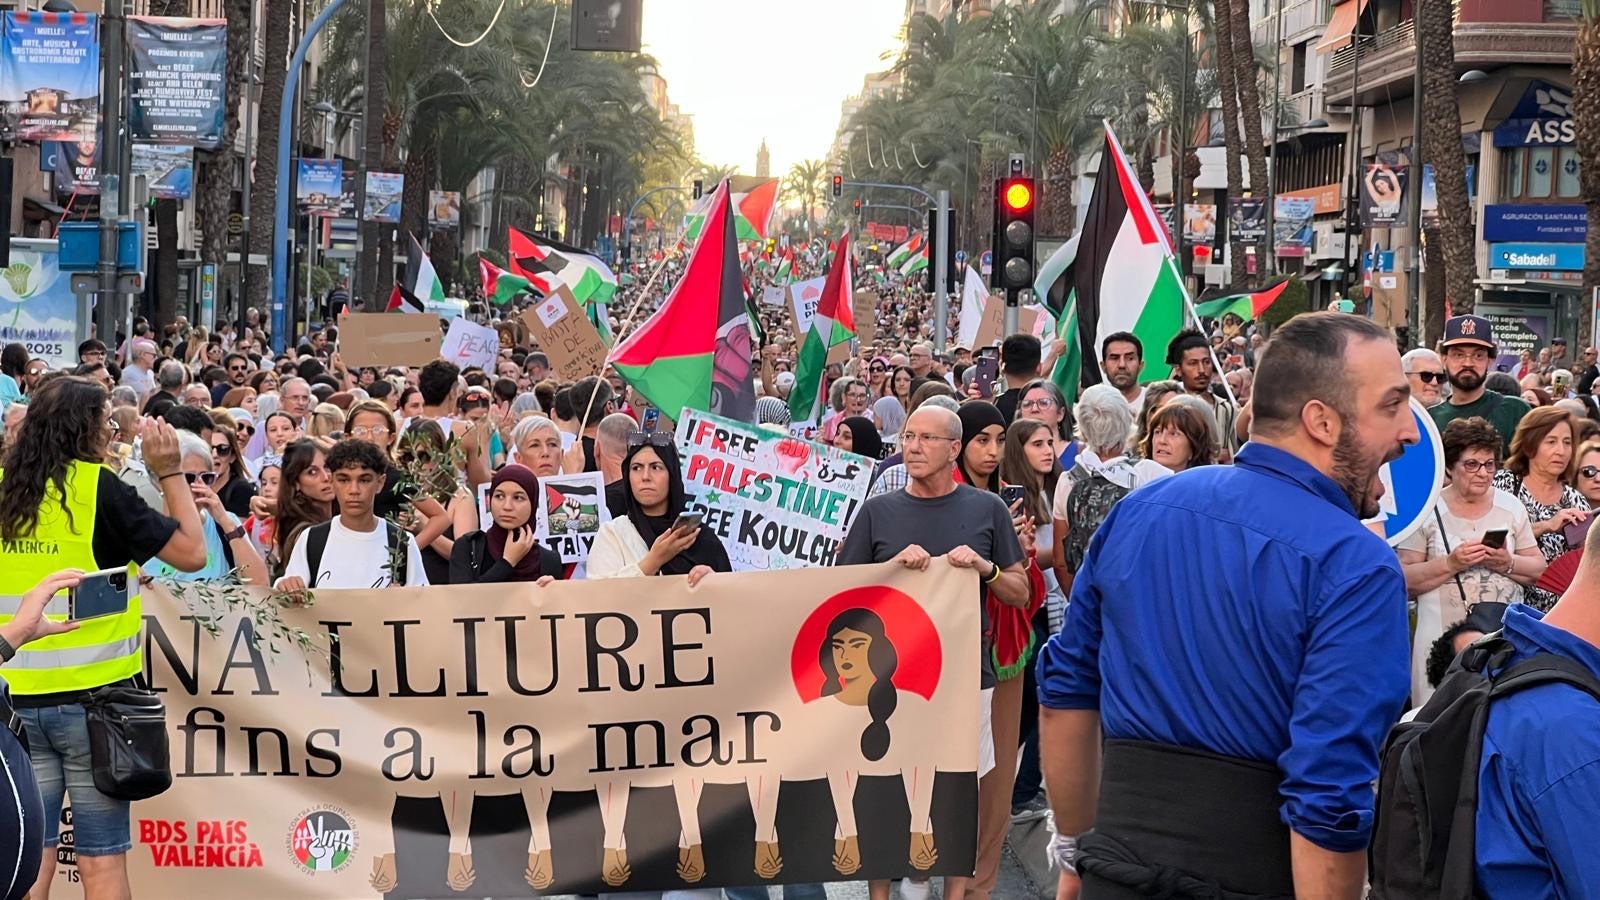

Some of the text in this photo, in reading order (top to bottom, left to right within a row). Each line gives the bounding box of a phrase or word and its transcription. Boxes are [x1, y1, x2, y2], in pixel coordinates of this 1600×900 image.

[1525, 120, 1576, 143] ASS
[1509, 253, 1556, 266] Sabadell
[1500, 316, 1528, 325] seguro
[1500, 332, 1538, 341] completo
[26, 343, 62, 354] 2025
[142, 608, 715, 698] NA LLIURE
[176, 706, 782, 781] fins a la mar
[62, 833, 74, 843] CO
[138, 819, 188, 844] BDS
[68, 869, 79, 883] IS
